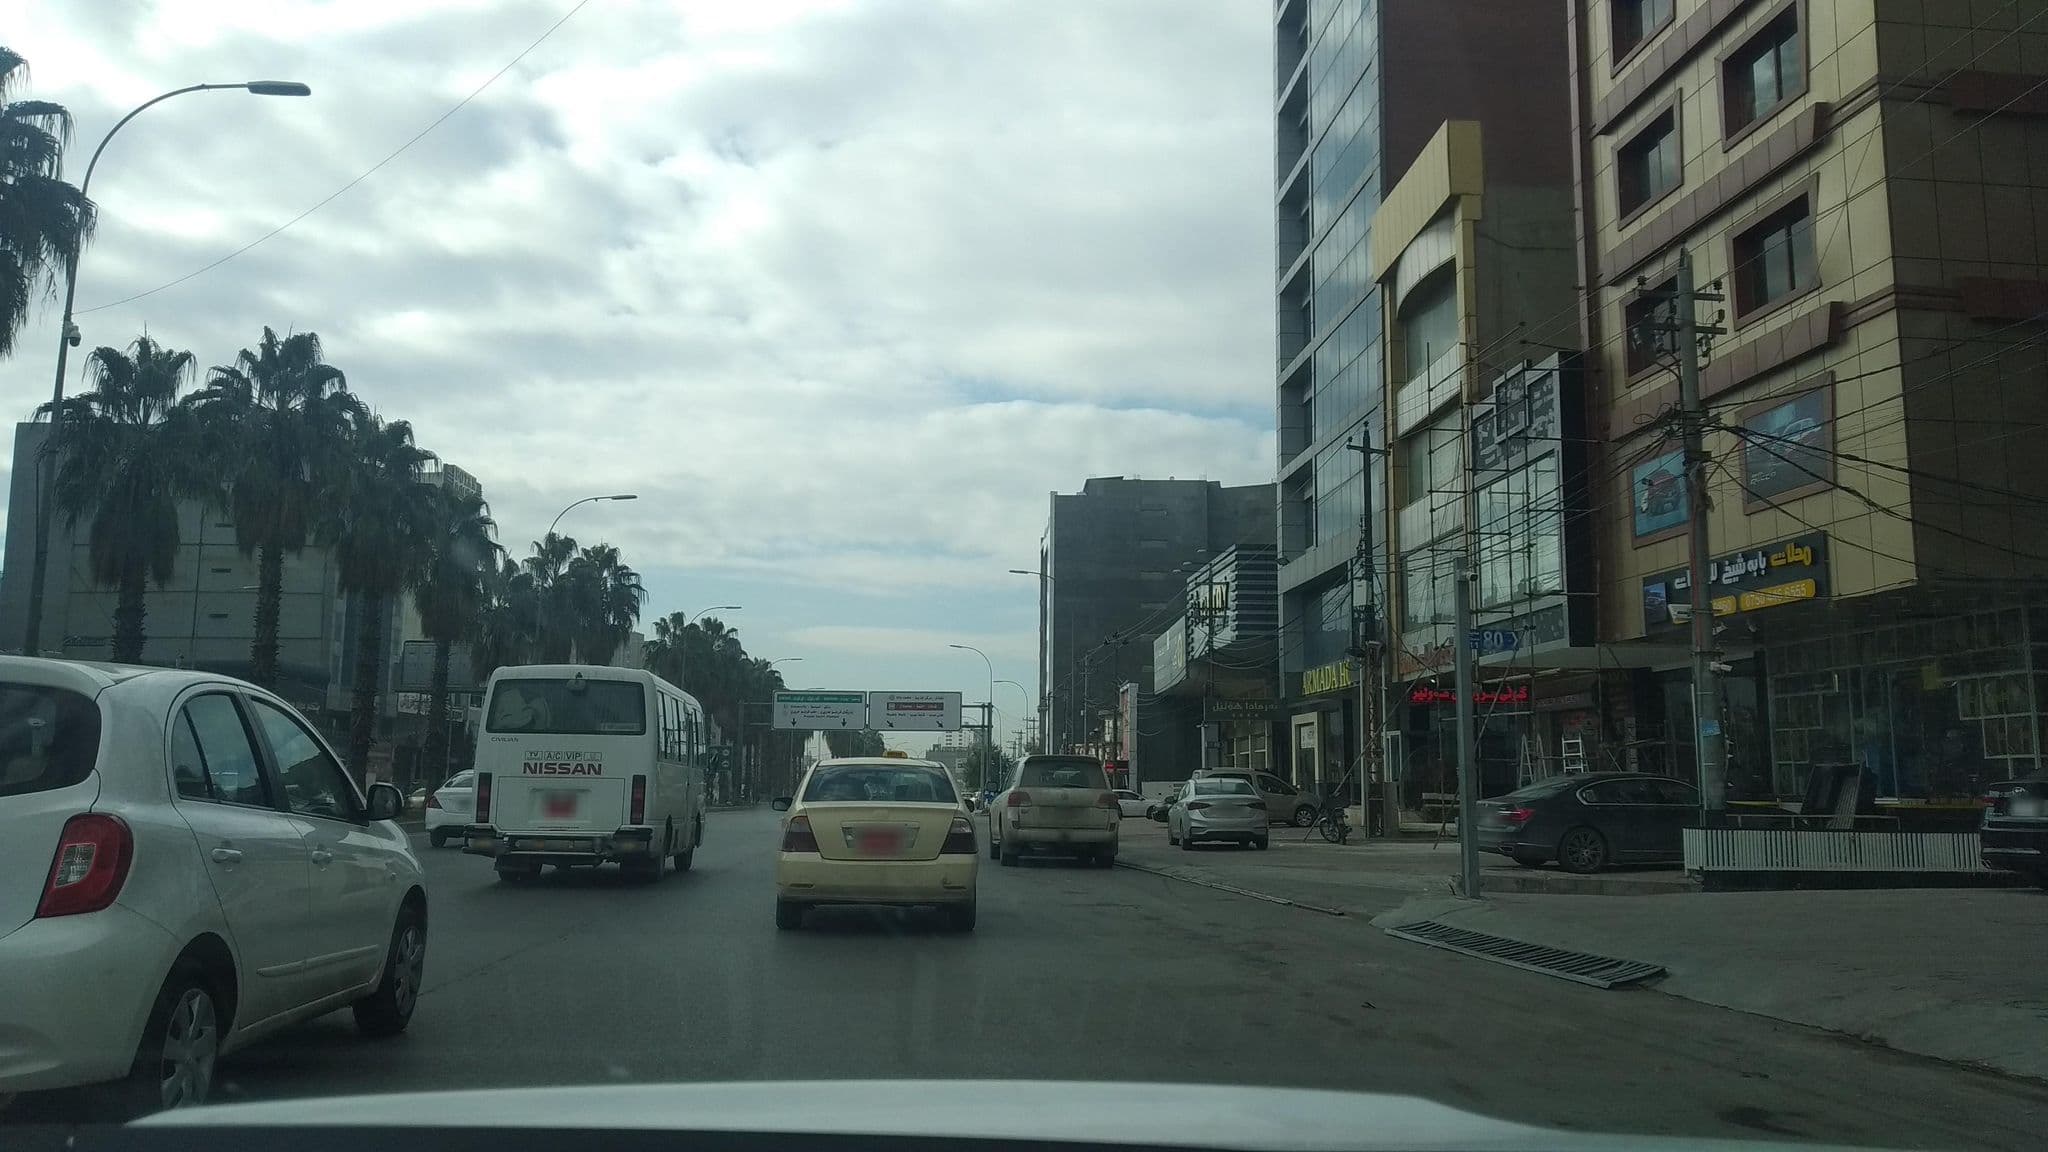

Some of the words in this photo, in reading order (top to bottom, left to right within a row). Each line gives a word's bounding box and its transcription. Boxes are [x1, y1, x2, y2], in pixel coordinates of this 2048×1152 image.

[1483, 631, 1504, 648] 80
[1303, 663, 1338, 695] ARMADA
[523, 762, 602, 775] NISSAN
